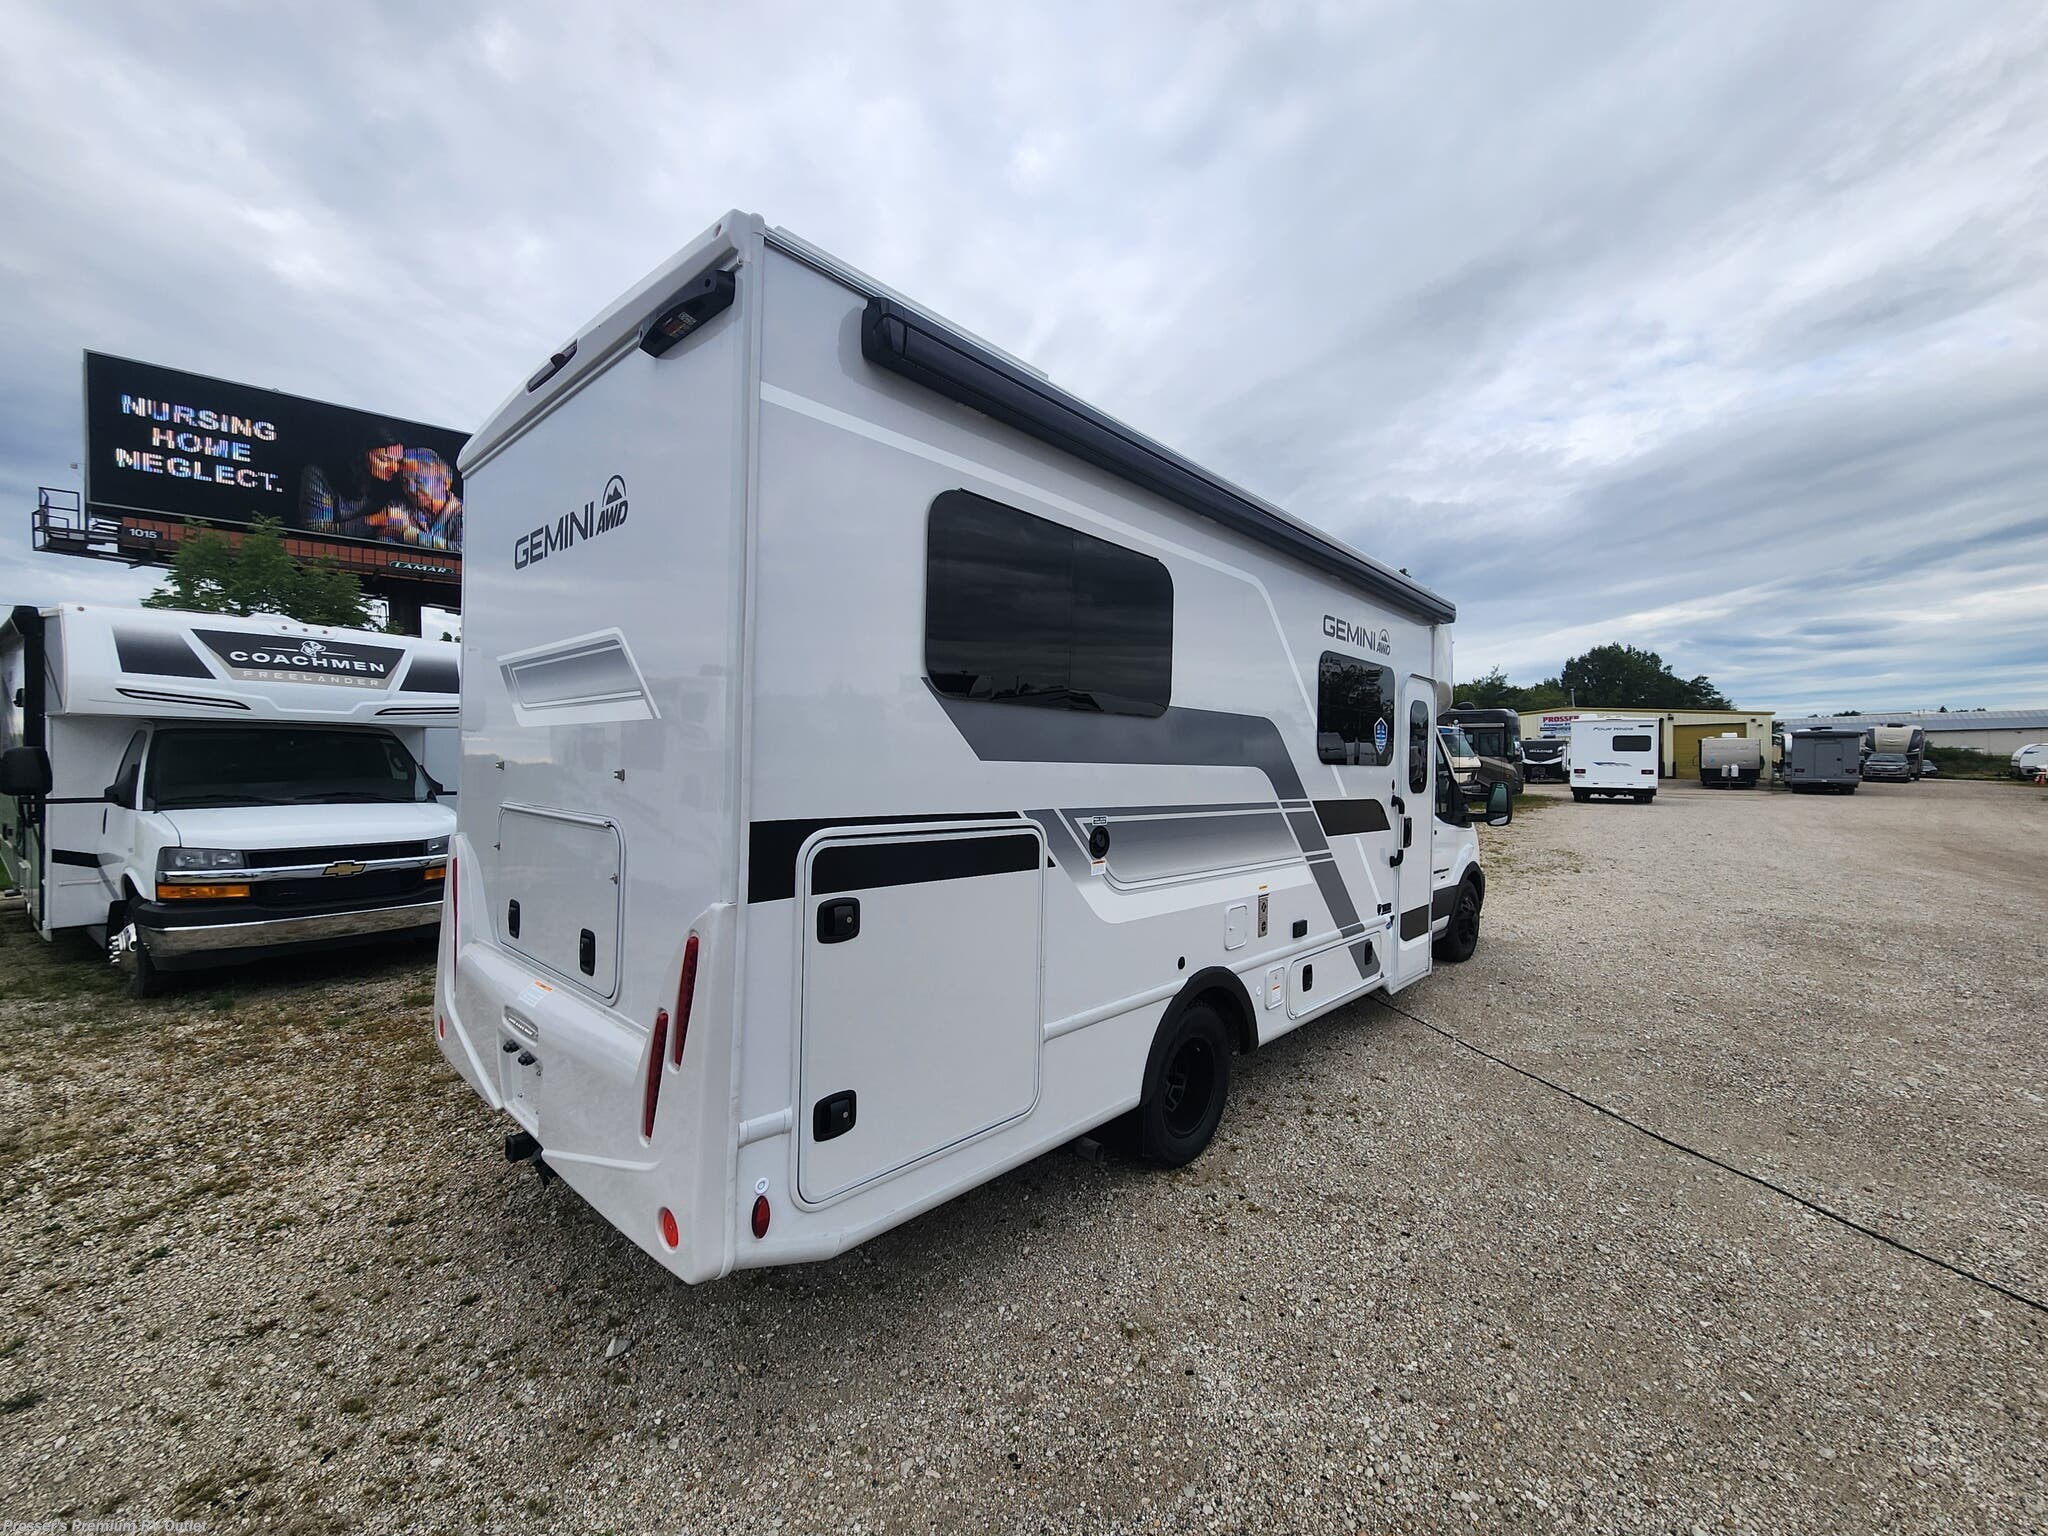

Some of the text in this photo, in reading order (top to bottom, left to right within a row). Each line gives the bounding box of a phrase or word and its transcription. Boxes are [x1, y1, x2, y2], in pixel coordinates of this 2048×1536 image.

[121, 394, 277, 441] NURSING
[151, 427, 251, 462] HOME
[116, 448, 283, 493] NEGLECT.
[129, 528, 157, 539] 1015
[514, 500, 628, 570] GEMINI AWD
[395, 562, 447, 573] LAMAR
[1322, 614, 1391, 656] GEMINI AWD
[229, 651, 385, 673] COACHMEN
[243, 670, 379, 687] FREELANDER
